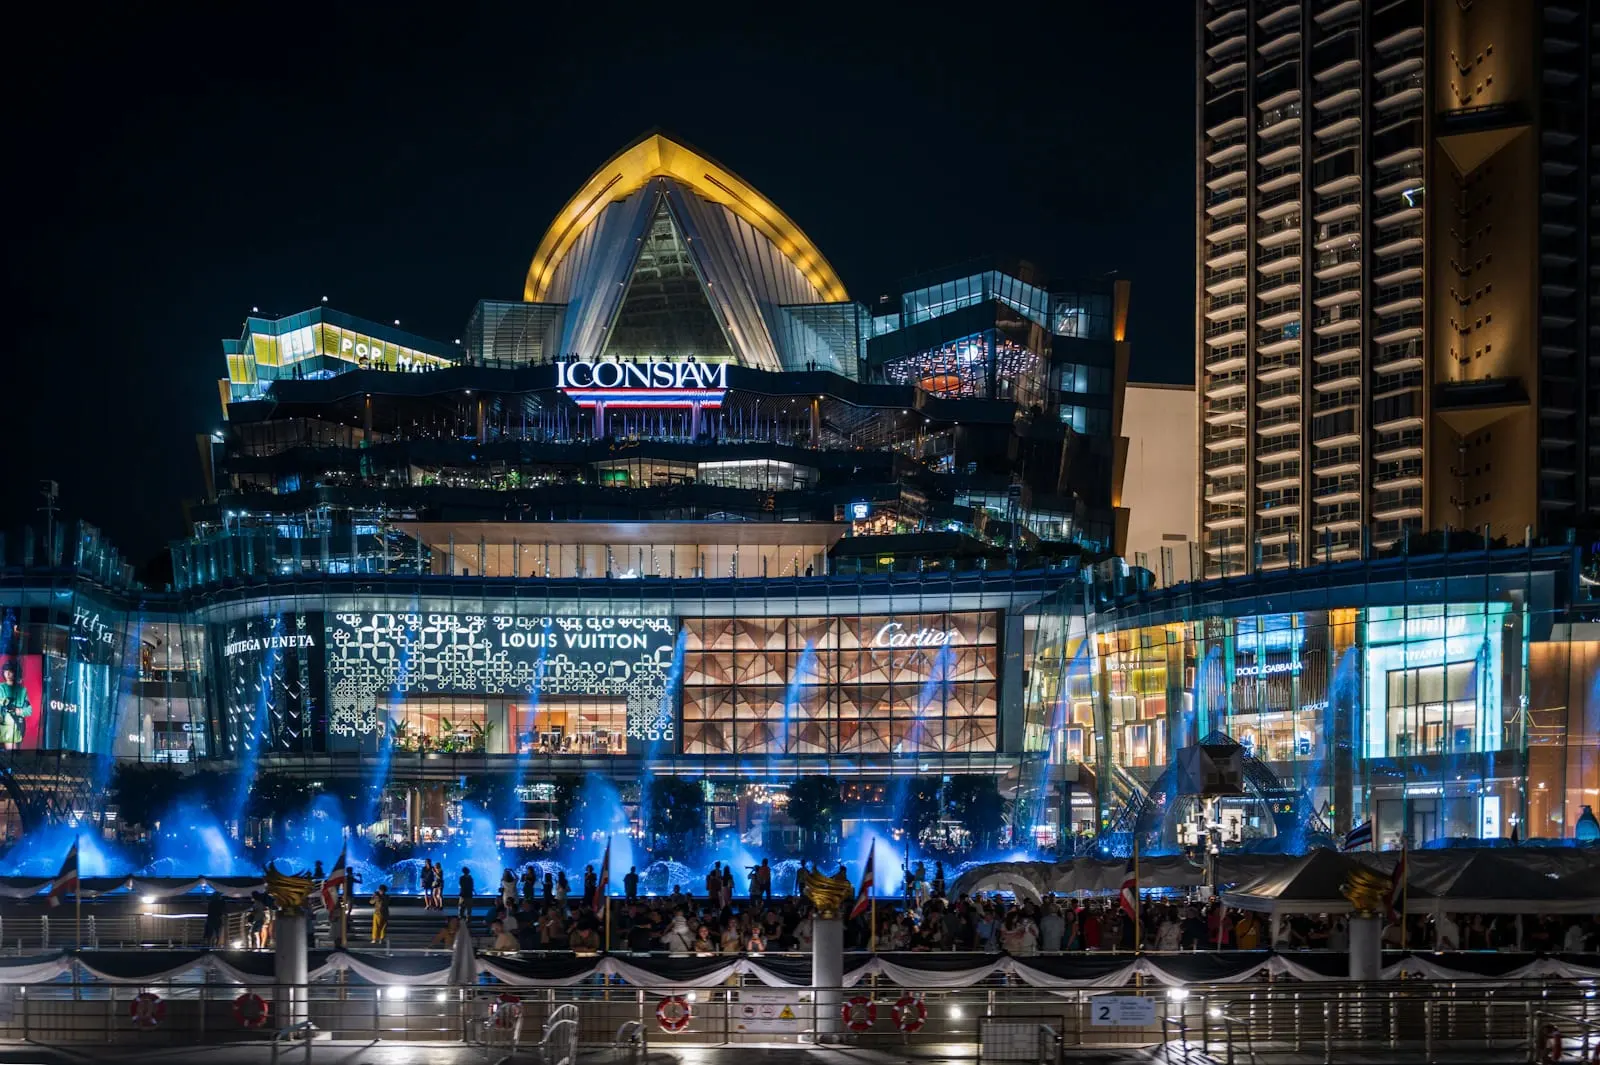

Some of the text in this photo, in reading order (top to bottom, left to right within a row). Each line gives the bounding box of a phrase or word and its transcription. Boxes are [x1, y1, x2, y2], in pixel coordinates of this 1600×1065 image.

[341, 338, 382, 360] POP
[556, 361, 728, 388] ICONSIAM
[501, 633, 647, 648] LOUIS VUITTON
[875, 622, 958, 647] Cartier
[224, 635, 316, 657] BOTTEGA VENETA
[1099, 1006, 1110, 1020] 2
